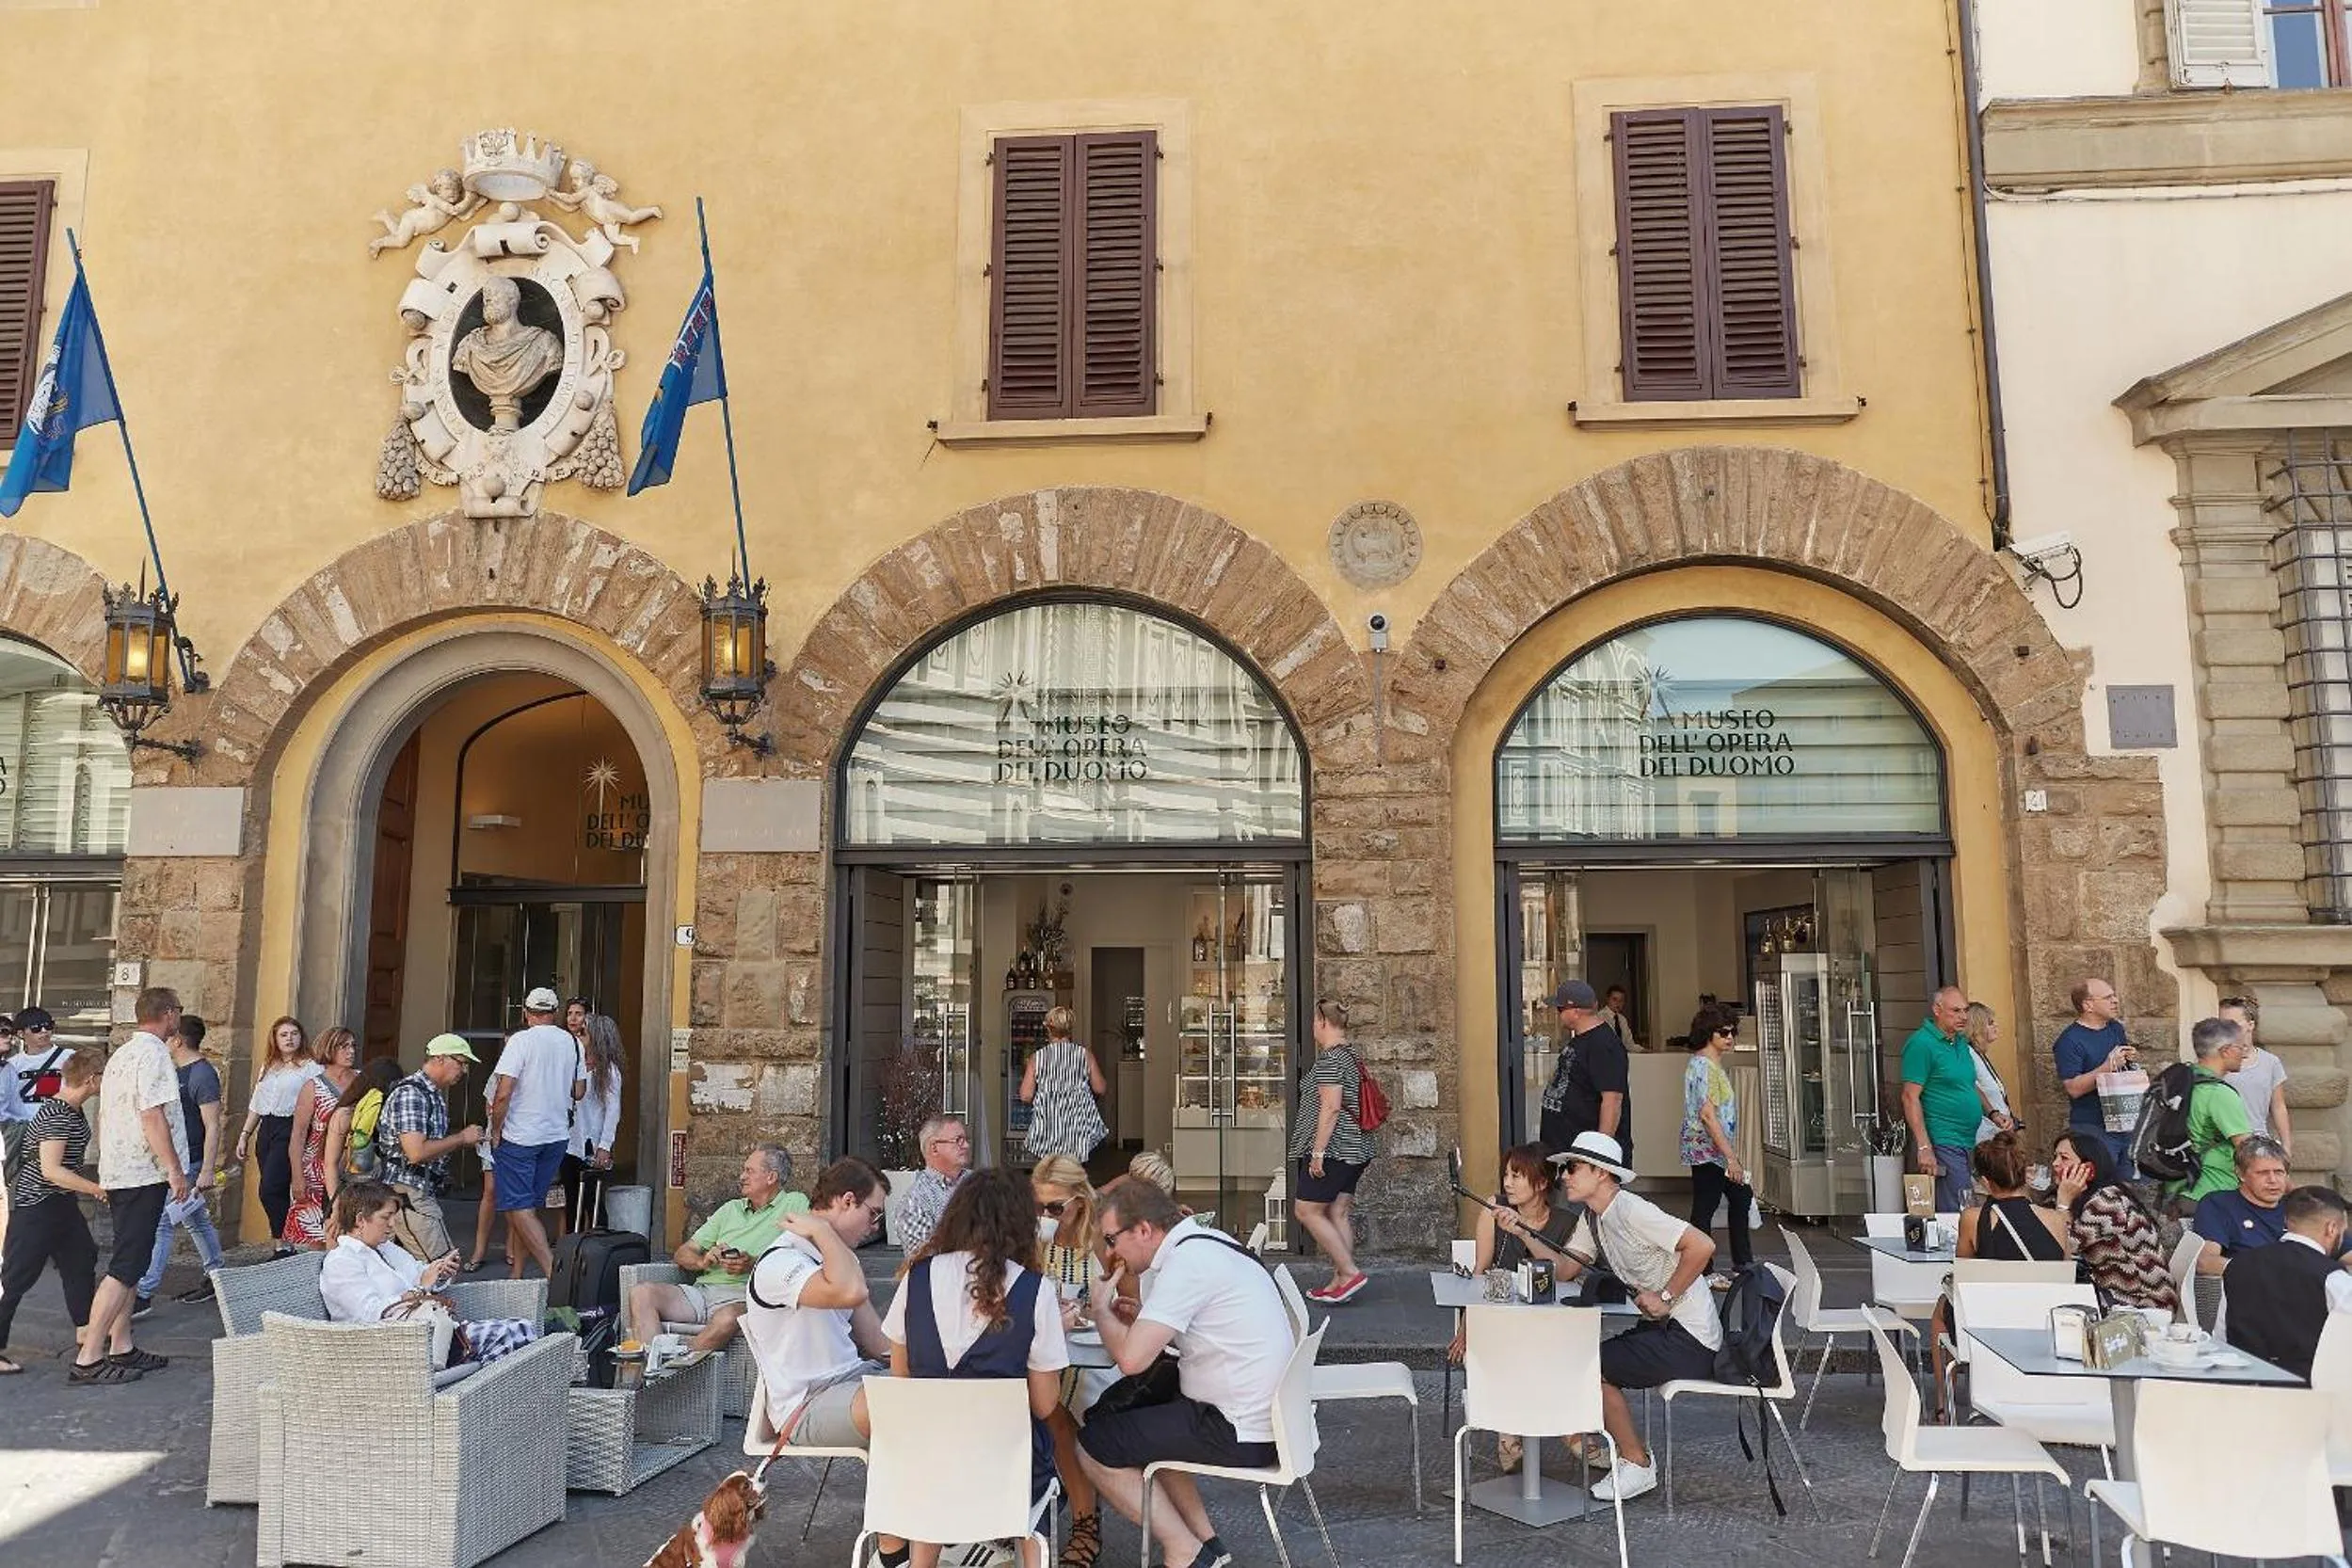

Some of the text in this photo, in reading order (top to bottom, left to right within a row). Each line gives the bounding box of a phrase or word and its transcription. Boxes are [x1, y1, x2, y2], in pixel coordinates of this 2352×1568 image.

[1041, 714, 1130, 735] MUSEO
[1683, 709, 1775, 729] MUSEO
[998, 760, 1147, 781] DEL DUOMO
[1640, 755, 1795, 776] DEL DUOMO
